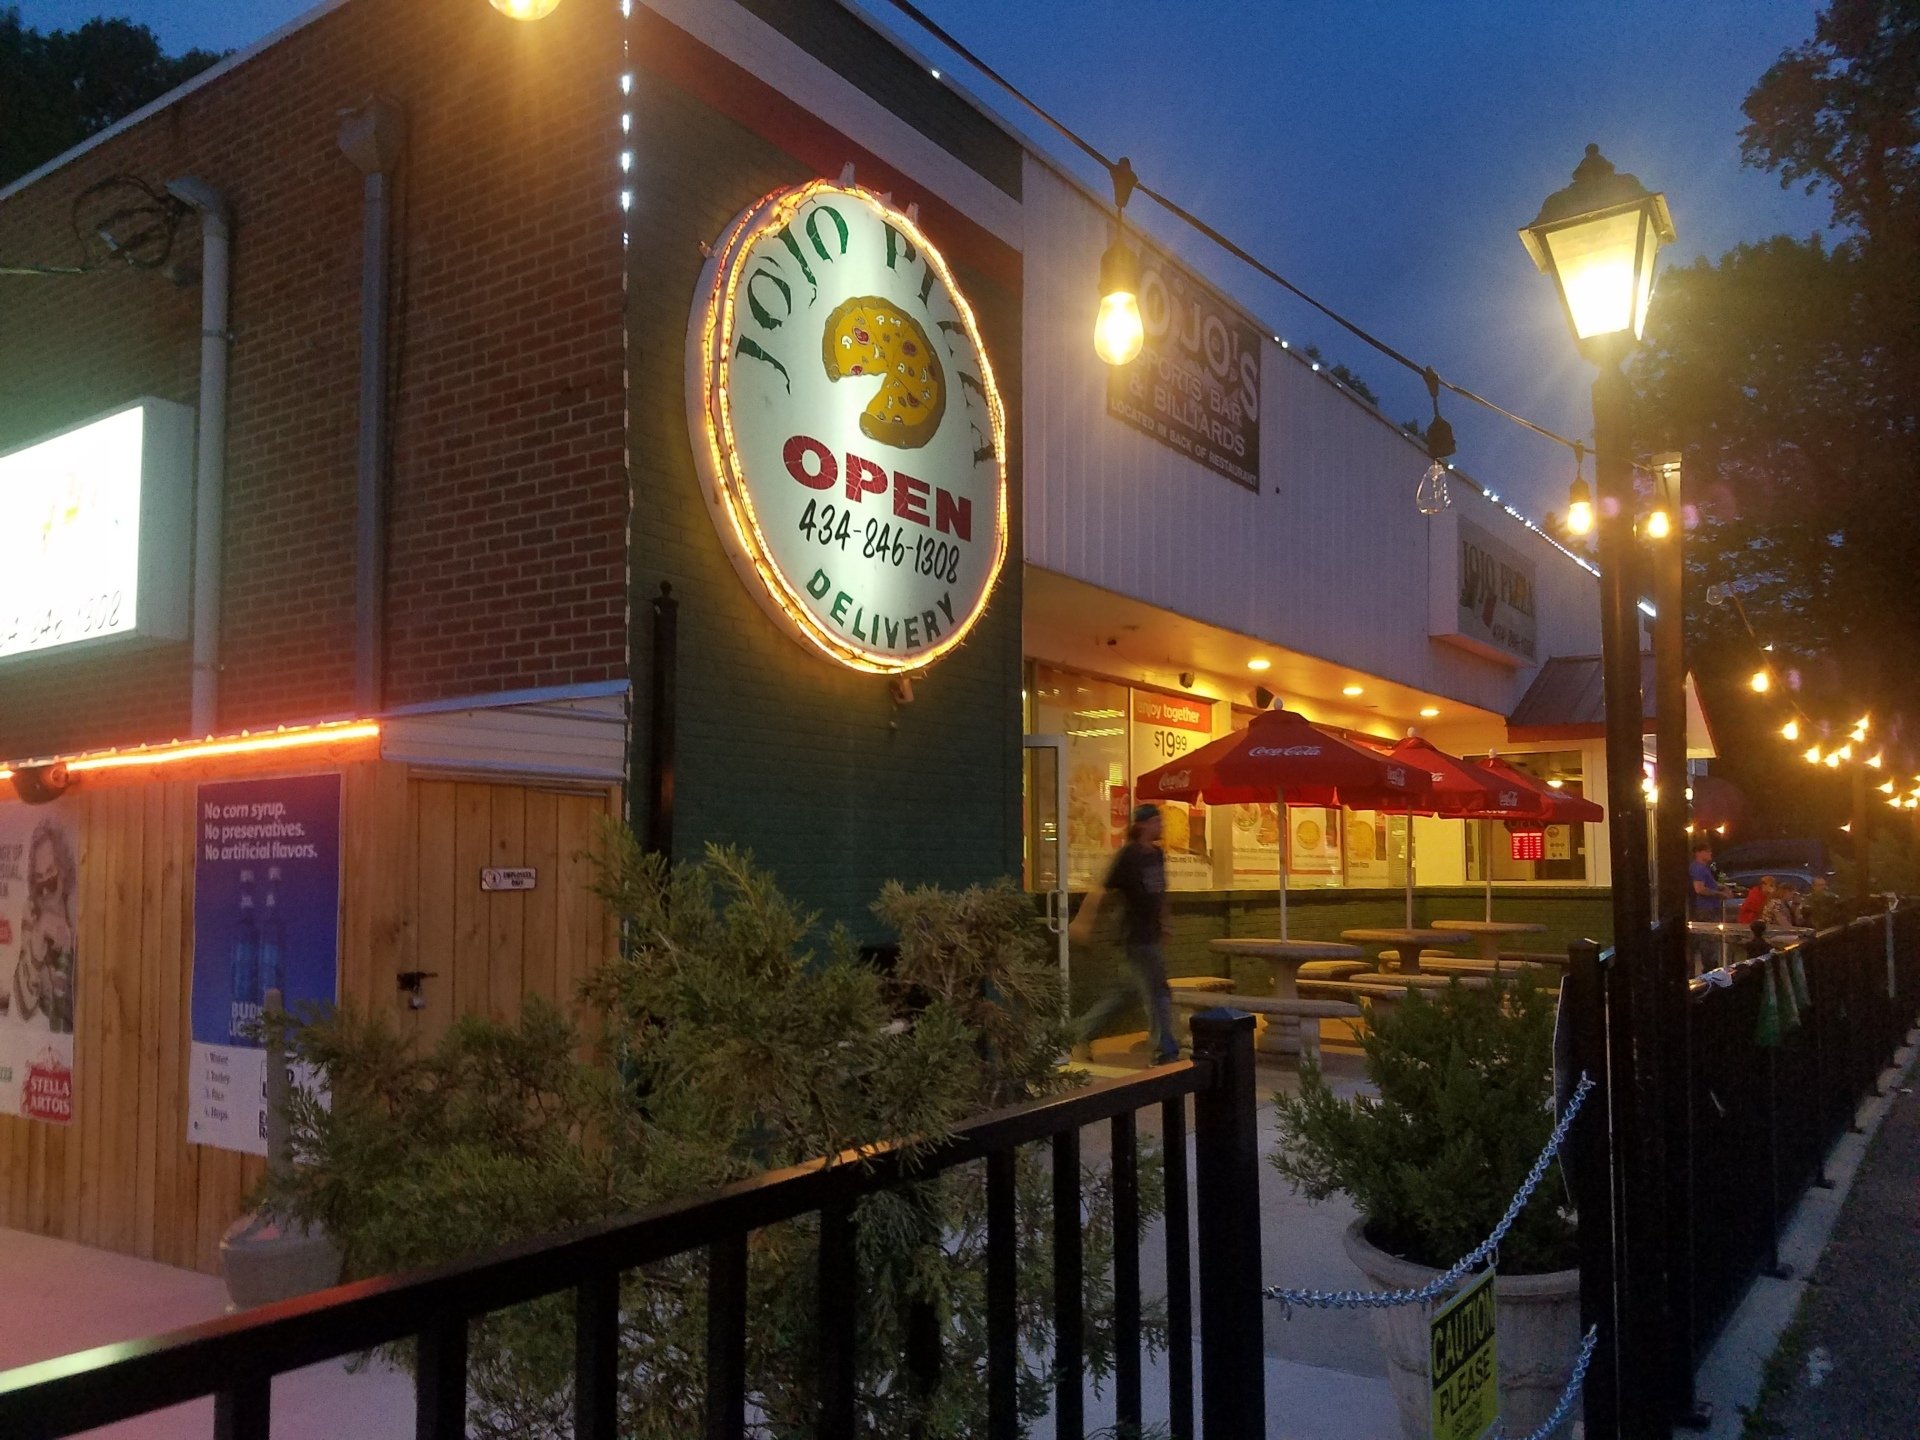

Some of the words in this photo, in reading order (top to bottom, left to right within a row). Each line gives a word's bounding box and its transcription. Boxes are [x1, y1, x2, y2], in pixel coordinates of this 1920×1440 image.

[1137, 268, 1258, 424] OJO'S
[1153, 384, 1246, 458] BILLIARDS
[1211, 388, 1243, 428] BAR
[1111, 398, 1156, 432] LOCATED
[1169, 429, 1193, 454] BACK
[1195, 444, 1208, 460] OF
[1208, 450, 1258, 487] RESTAURANT
[782, 434, 973, 543] OPEN
[799, 499, 961, 584] 434-846-1308
[806, 567, 956, 650] DELIVERY
[1163, 704, 1200, 724] together
[1248, 744, 1321, 757] Coca-Cola
[204, 802, 221, 819] No
[223, 804, 249, 819] corn
[252, 801, 287, 821] syrup.
[204, 822, 221, 840] No
[222, 820, 306, 844] preservatives.
[204, 843, 220, 861] No
[221, 841, 271, 860] artificial
[272, 842, 319, 859] flavors.
[30, 1078, 71, 1097] STELLA
[30, 1095, 71, 1114] ARTOIS
[1432, 1284, 1496, 1380] CAUTION
[1439, 1346, 1492, 1427] PLEASE
